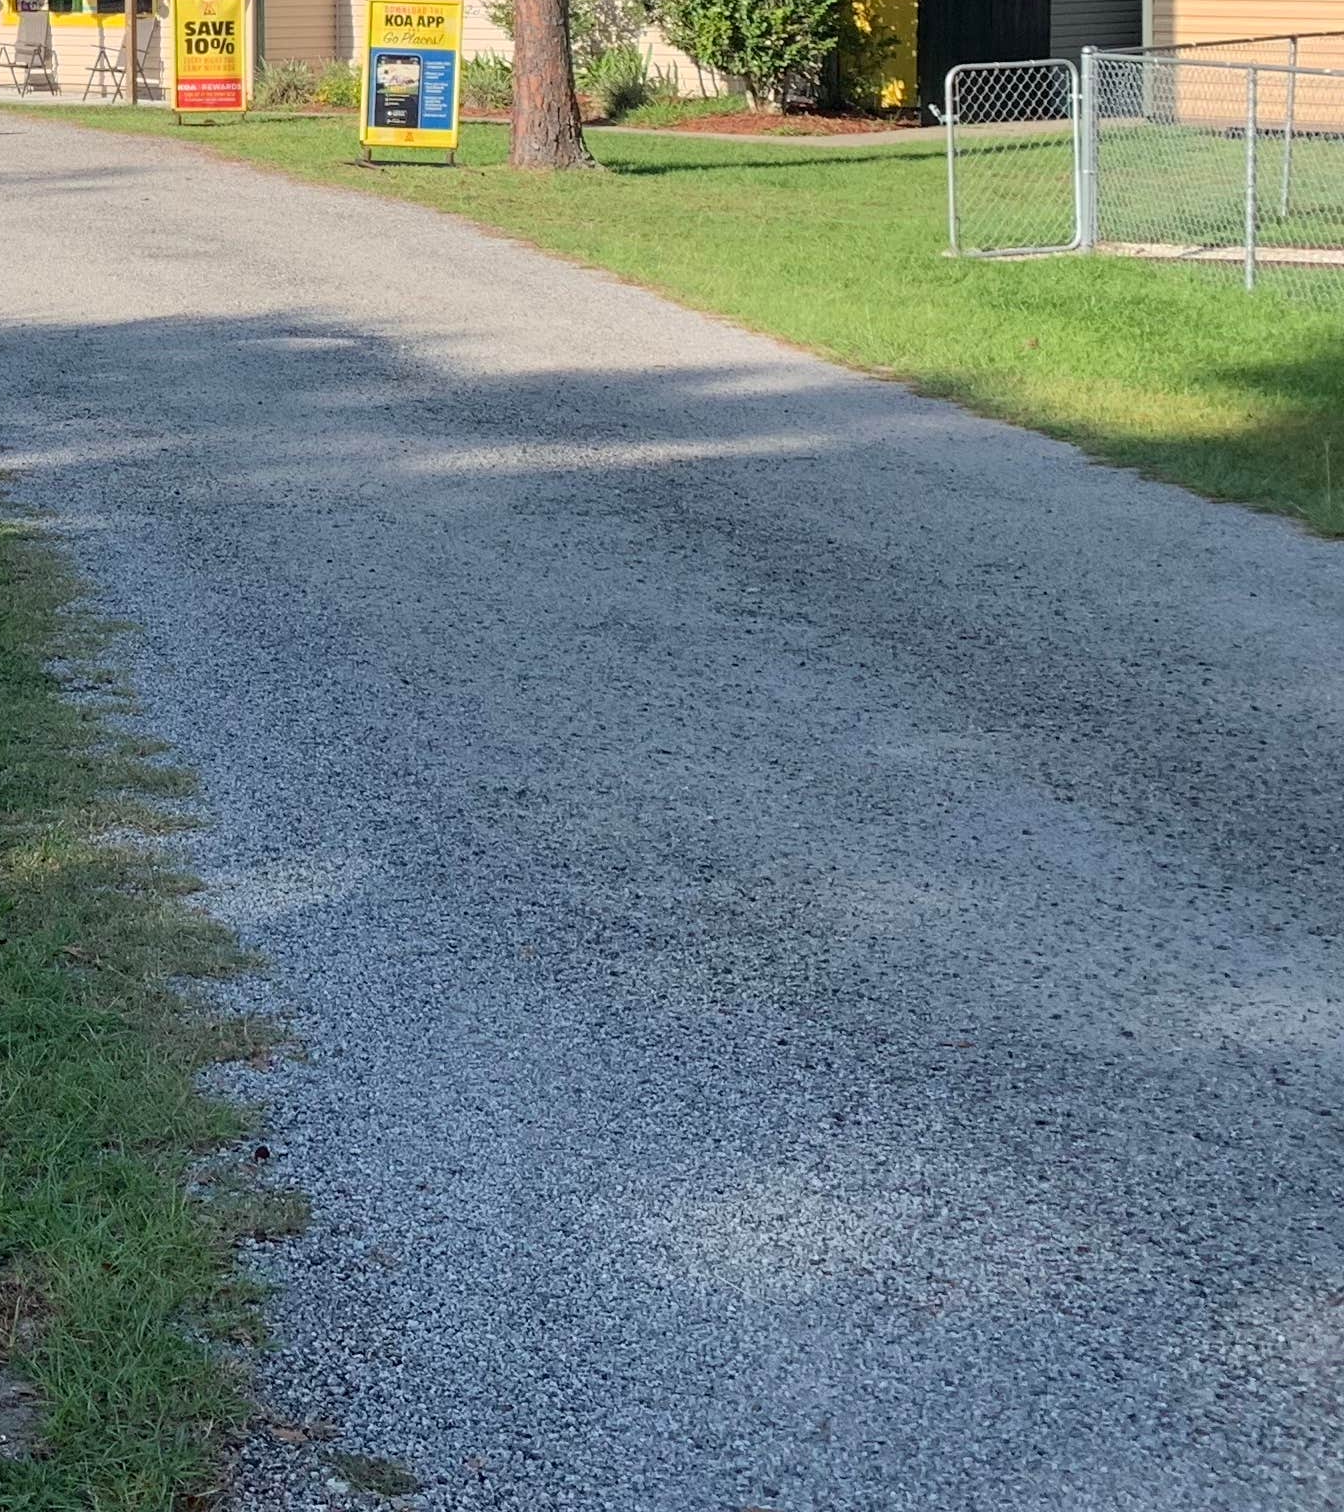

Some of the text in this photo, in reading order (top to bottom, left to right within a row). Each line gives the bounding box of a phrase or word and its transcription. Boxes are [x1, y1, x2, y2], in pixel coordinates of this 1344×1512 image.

[384, 14, 445, 29] KOA APP
[184, 21, 236, 37] SAVE
[383, 31, 399, 44] Go
[201, 83, 241, 91] REWARDS
